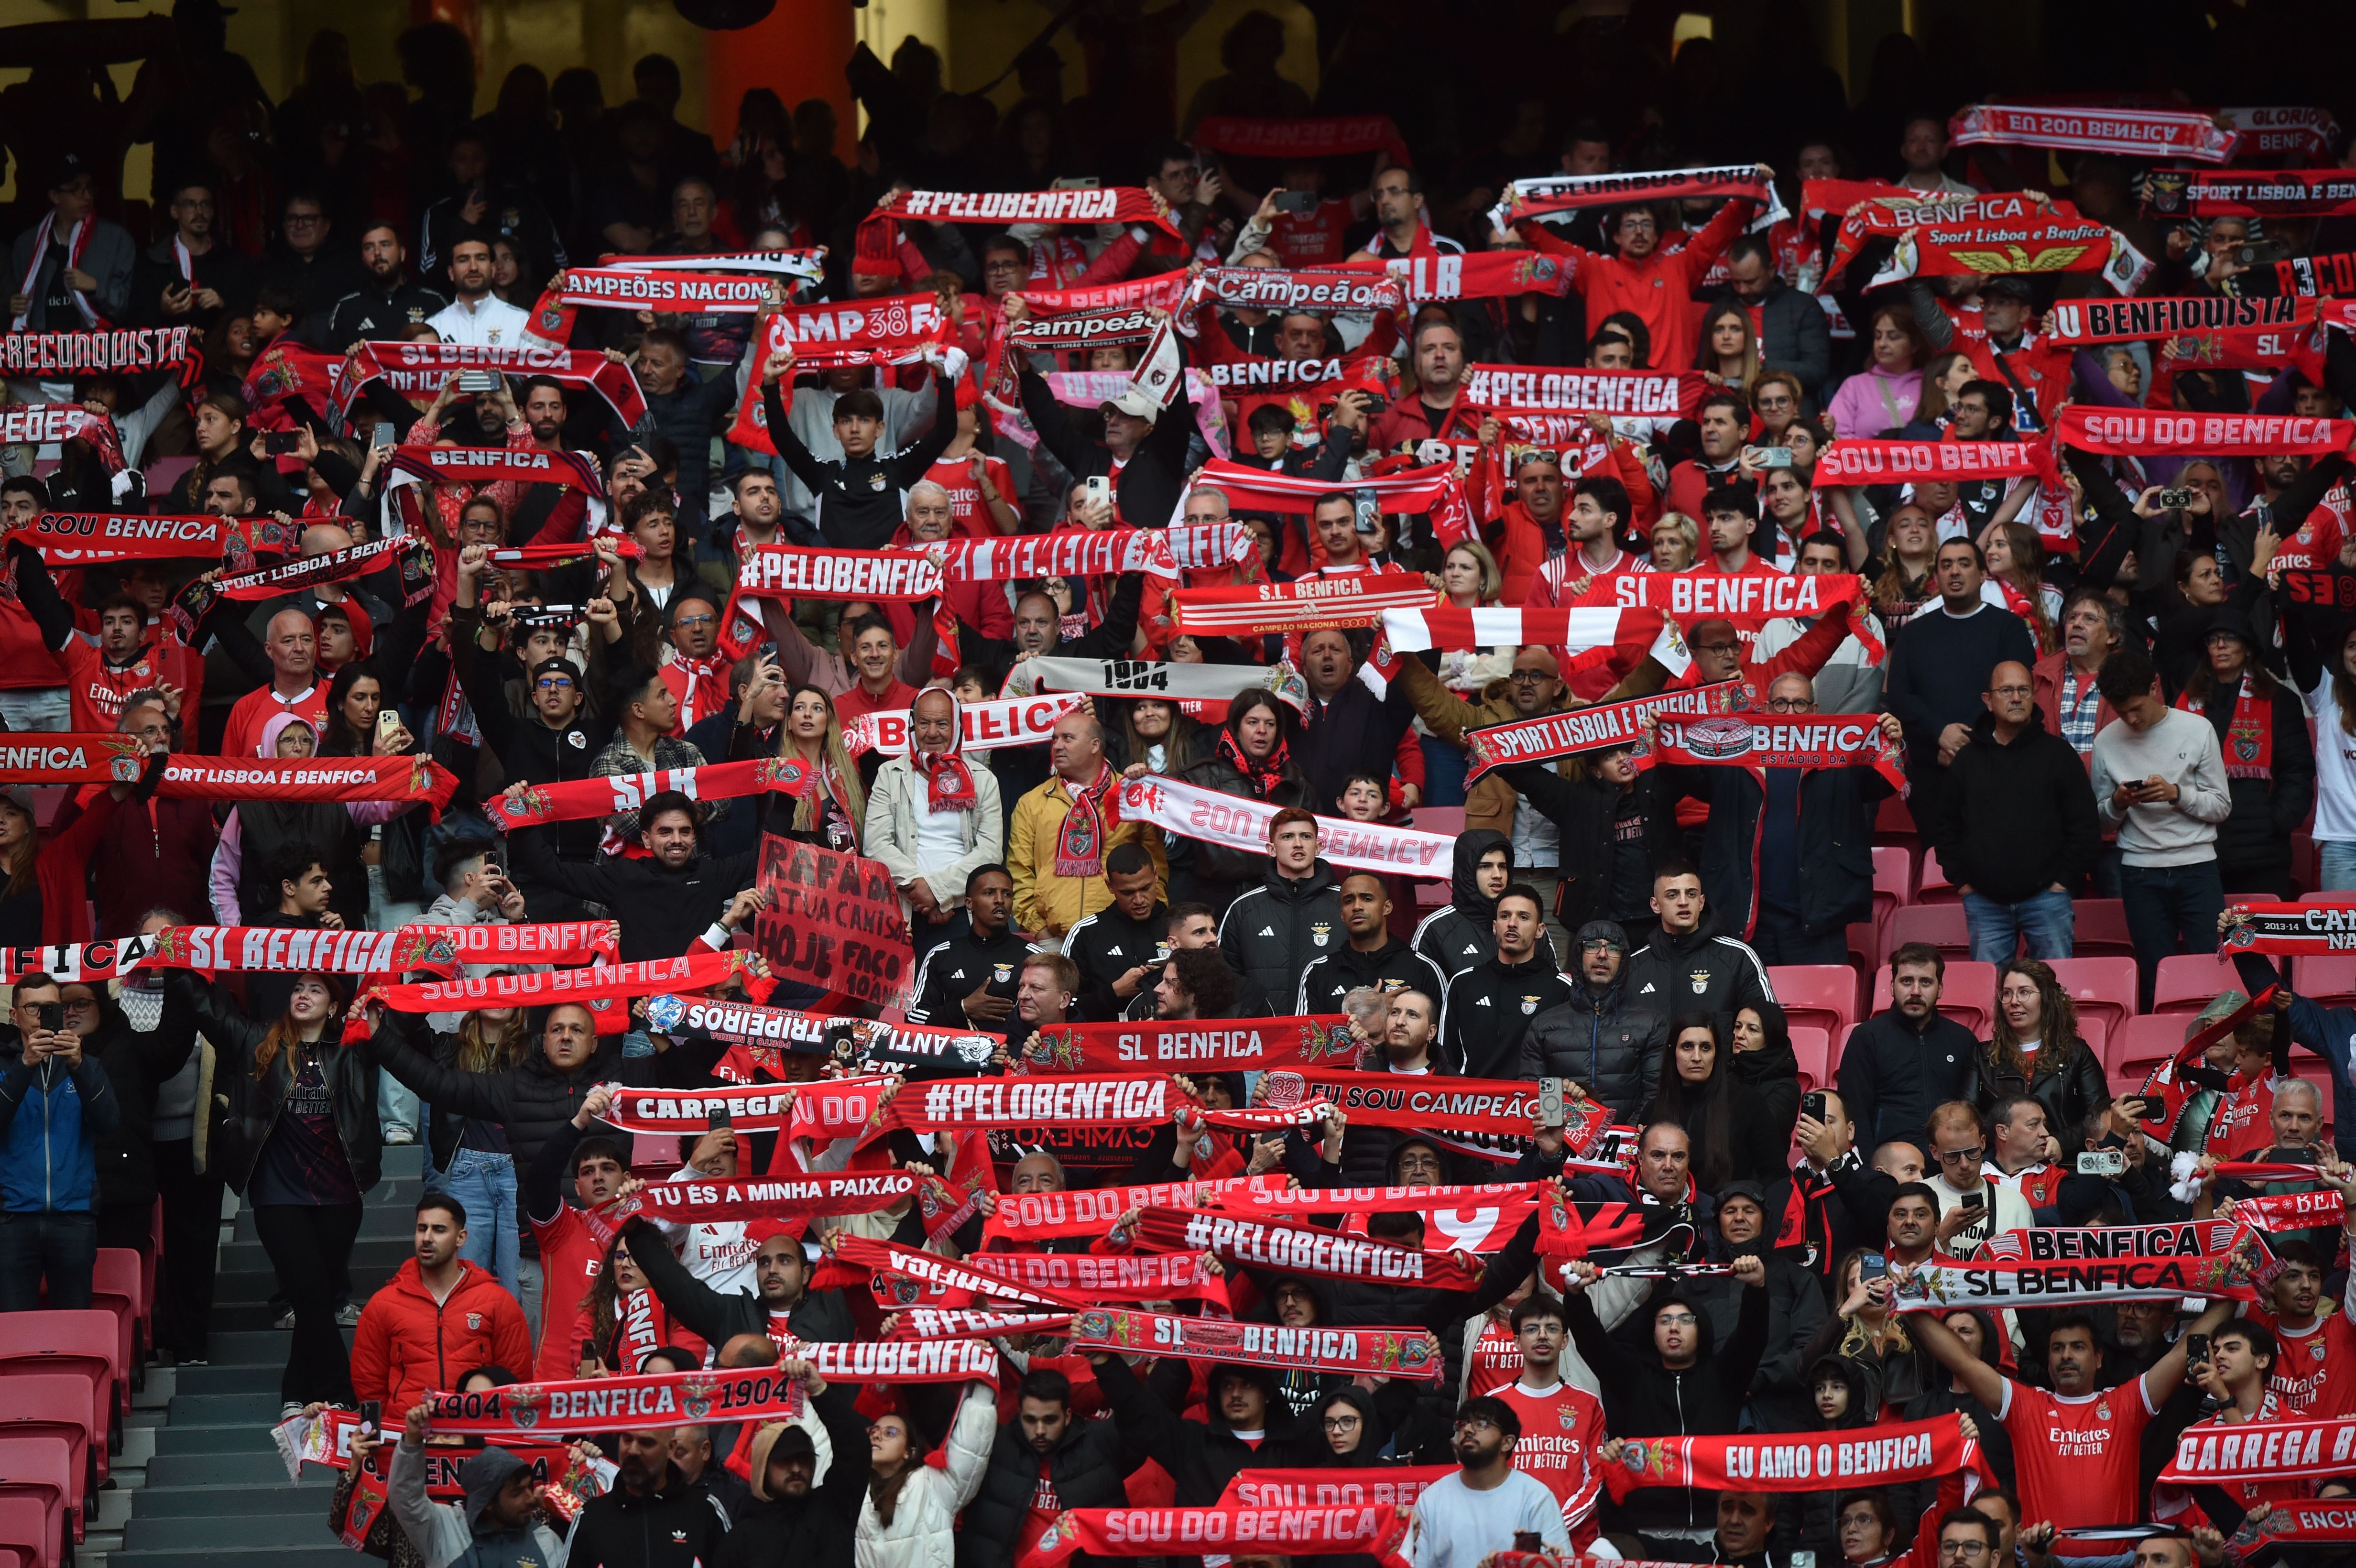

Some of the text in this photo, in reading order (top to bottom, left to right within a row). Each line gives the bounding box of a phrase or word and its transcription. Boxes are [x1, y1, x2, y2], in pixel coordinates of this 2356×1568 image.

[1527, 187, 1544, 204] E
[1551, 172, 1686, 200] PLURIBUS
[2186, 186, 2241, 201] SPORT
[2247, 185, 2307, 200] LISBOA
[2311, 186, 2323, 199] E
[907, 190, 1117, 219] #PELOBENFICA
[1928, 225, 2106, 246] Sport Lisboa e Benfica
[680, 282, 772, 301] NACION
[1217, 279, 1371, 306] Campeão
[401, 346, 572, 370] SL BENFICA
[2257, 335, 2286, 356] SL
[1211, 358, 1343, 386] BENFICA
[1062, 375, 1094, 399] EU
[1467, 370, 1679, 413] #PELOBENFICA
[2084, 416, 2332, 445] SOU DO BENFICA
[431, 450, 550, 469] BENFICA
[1822, 448, 1883, 476] SOU
[1889, 446, 1934, 473] DO
[38, 515, 217, 541] SOU BENFICA
[211, 572, 267, 593] SPORT
[271, 555, 332, 582] LISBOA
[335, 549, 347, 564] E
[739, 552, 944, 596] #PELOBENFICA
[1259, 578, 1363, 601] S.L. BENFICA
[1672, 575, 1819, 613] BENFICA
[1253, 620, 1340, 633] CAMPEÃO NACIONAL
[1294, 612, 1324, 621] adidas
[1103, 659, 1168, 691] 1904
[1492, 726, 1555, 759] SPORT
[1555, 712, 1622, 745] LISBOA
[1624, 714, 1634, 735] E
[1659, 722, 1882, 752] SL BENFICA
[1760, 753, 1876, 765] ESTÁDIO DA LUZ
[163, 767, 377, 784] ORT LISBOA E BENFICA
[764, 839, 862, 896] RAFA
[2264, 922, 2300, 931] 2013-14
[188, 926, 398, 972] SL BENFICA
[757, 918, 837, 979] HOJE
[497, 973, 543, 995] DO
[552, 956, 691, 991] BENFICA
[705, 999, 805, 1018] SEMPRE BENFICA
[687, 1008, 951, 1056] TRIPEIROS ANTI
[710, 1031, 791, 1049] MERDA É PORTO
[1118, 1030, 1264, 1061] SL BENFICA
[924, 1080, 1167, 1122] #PELOBENFICA
[1271, 1077, 1297, 1099] 32
[1309, 1083, 1342, 1106] EU
[1346, 1087, 1406, 1111] SOU
[295, 1100, 332, 1115] BETTER
[822, 1096, 866, 1125] DO
[648, 1175, 914, 1206] TU ÉS A MINHA PAIXÃO
[998, 1198, 1066, 1228] SOU
[1073, 1190, 1119, 1222] DO
[1184, 1213, 1424, 1280] #PELOBENFICA
[2027, 1227, 2201, 1261] BENFICA
[1025, 1255, 1211, 1288] DO BENFICA
[1963, 1263, 2186, 1298] SL BENFICA
[1154, 1317, 1358, 1361] SL BENFICA
[1288, 1357, 1320, 1365] LUZ
[2271, 1369, 2327, 1392] mirates
[433, 1377, 789, 1419] 1904 BENFICA 1904
[1515, 1434, 1580, 1454] mirates
[2049, 1427, 2110, 1443] Emirates
[2058, 1442, 2103, 1456] FLY BETTER
[1514, 1453, 1569, 1470] FLY BETTER
[1726, 1432, 1932, 1479] EU AMO O BENFICA
[2176, 1430, 2323, 1472] CARREGA
[1105, 1508, 1379, 1543] SOU DO BENFICA
